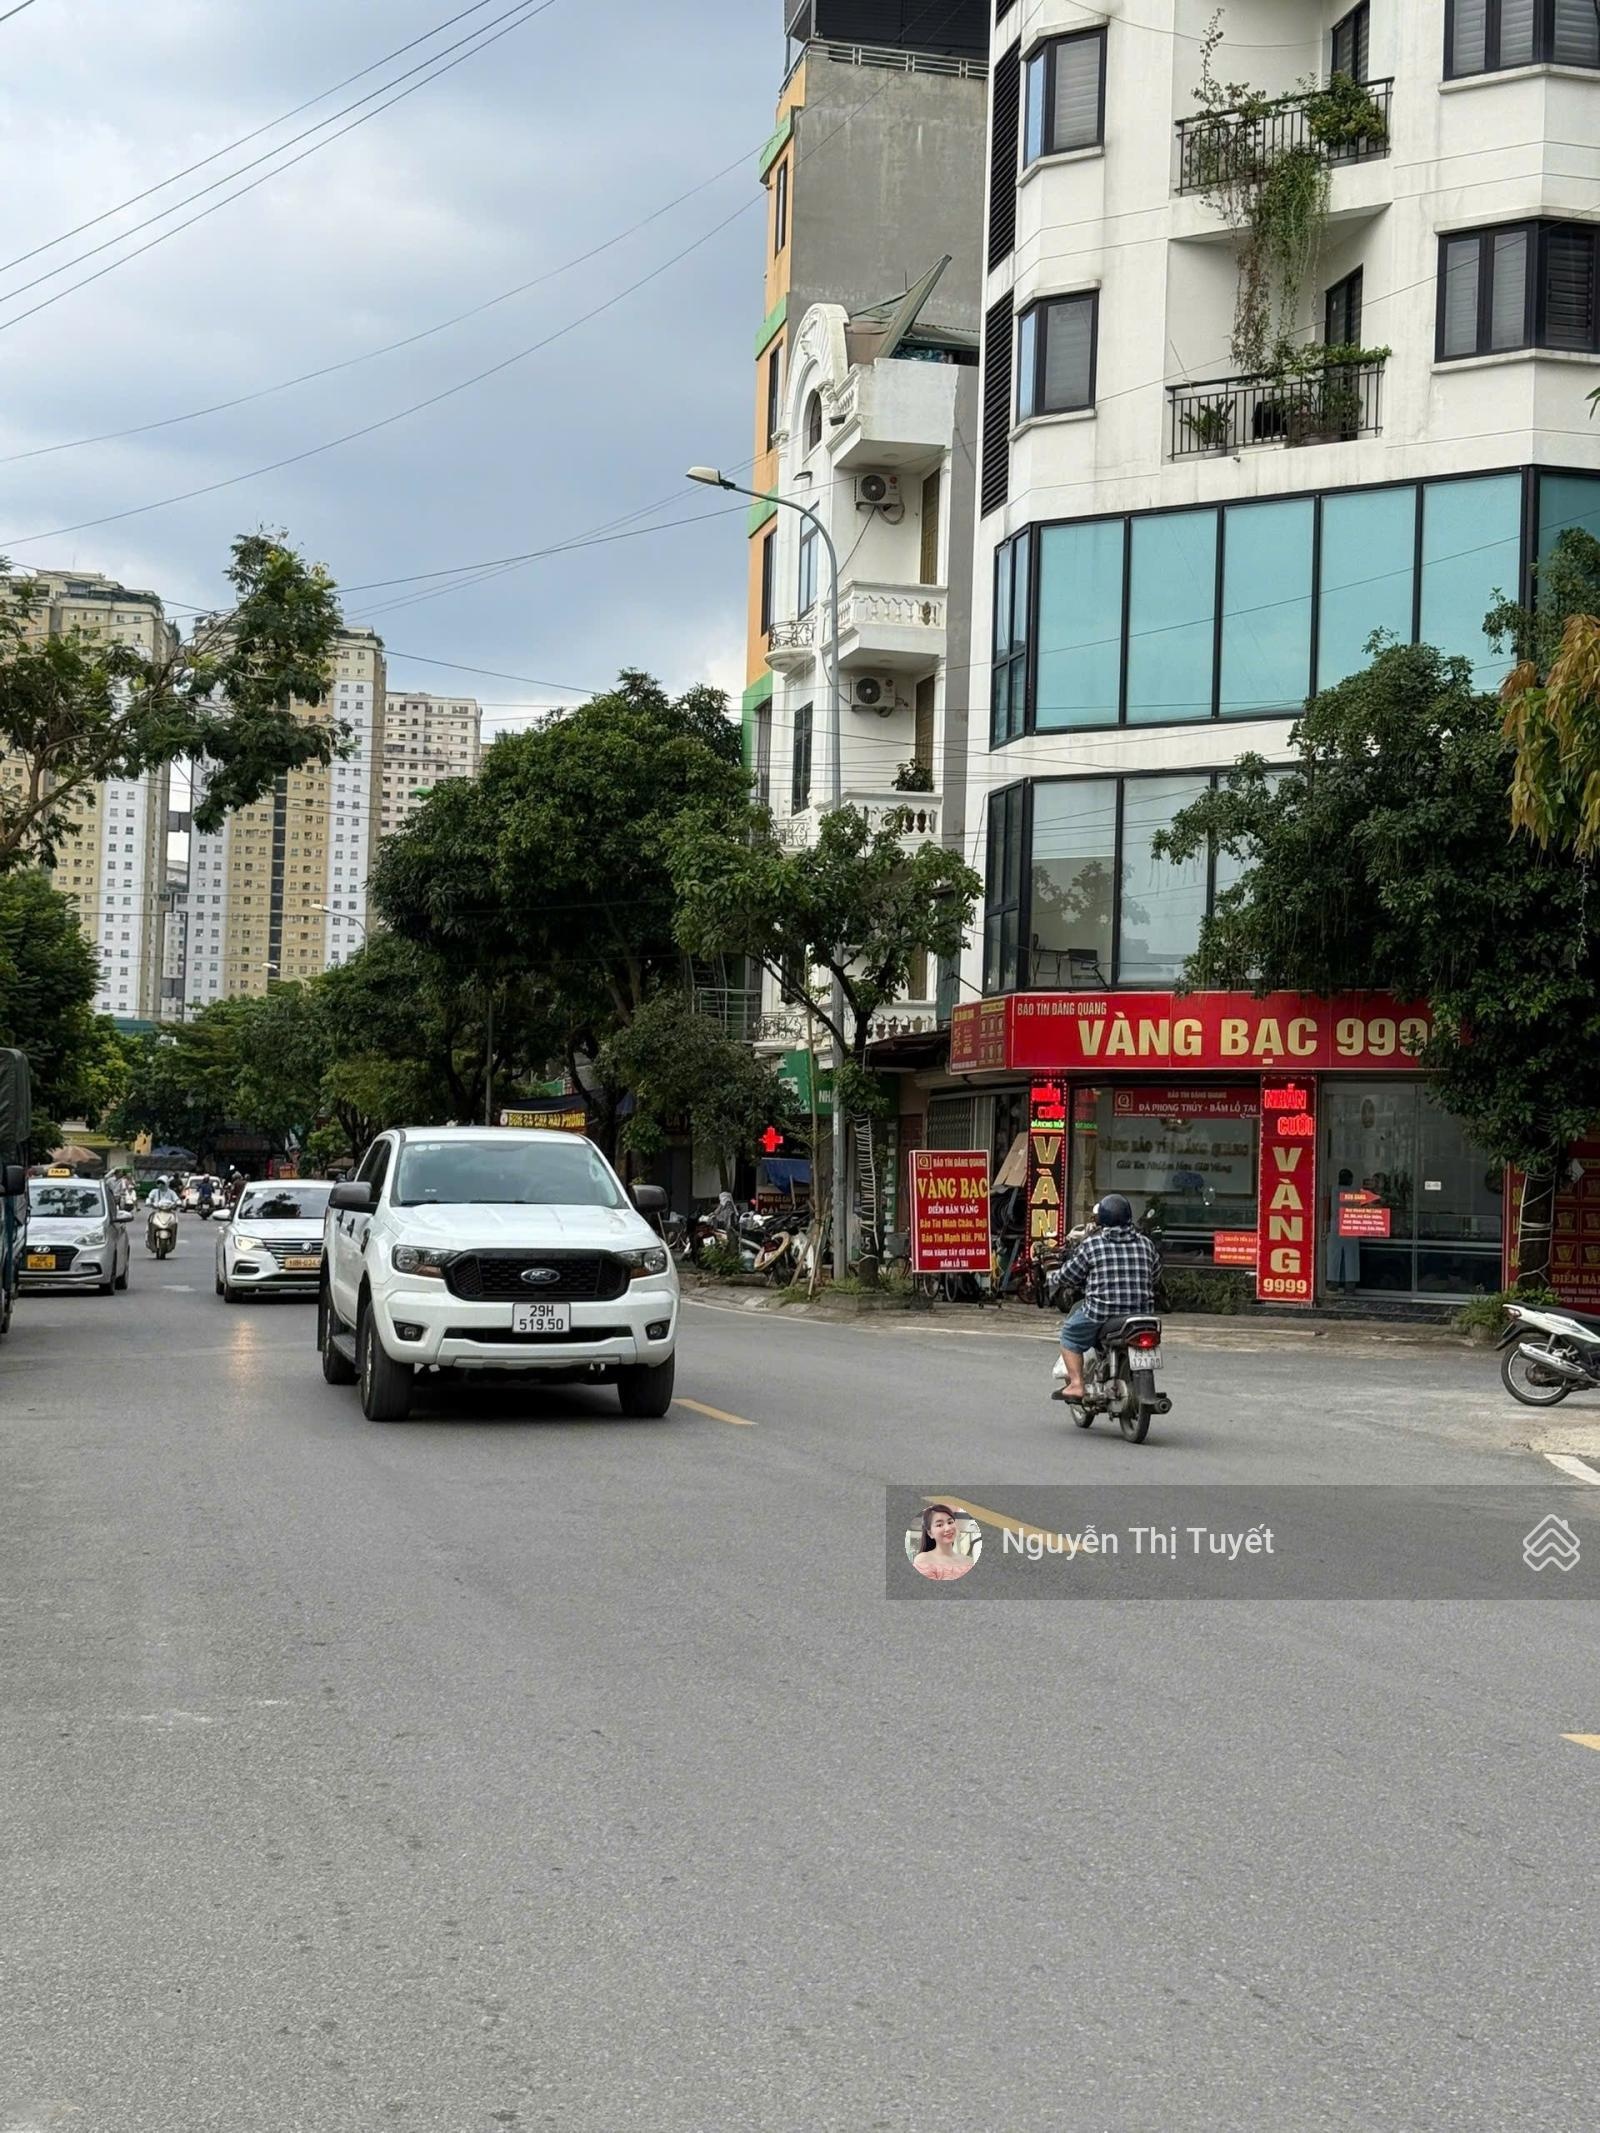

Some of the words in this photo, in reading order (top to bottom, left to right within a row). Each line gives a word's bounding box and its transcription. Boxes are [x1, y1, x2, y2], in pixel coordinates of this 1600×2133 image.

[1018, 999, 1034, 1016] BẢO
[1037, 1000, 1049, 1016] TÍN
[1078, 1002, 1107, 1016] QUANG
[1078, 1012, 1203, 1056] VÀNG
[1220, 1018, 1318, 1065] BẠC
[1336, 1018, 1461, 1056] 999
[1152, 1103, 1179, 1112] PHONG
[1243, 1104, 1257, 1113] TAI
[917, 1172, 957, 1199] VÀNG
[960, 1177, 988, 1204] BẠC
[960, 1204, 979, 1214] VÀNG
[1269, 1147, 1304, 1274] VÀNG
[1263, 1278, 1307, 1295] 9999
[529, 1305, 554, 1317] 29H
[519, 1318, 564, 1330] 519.50
